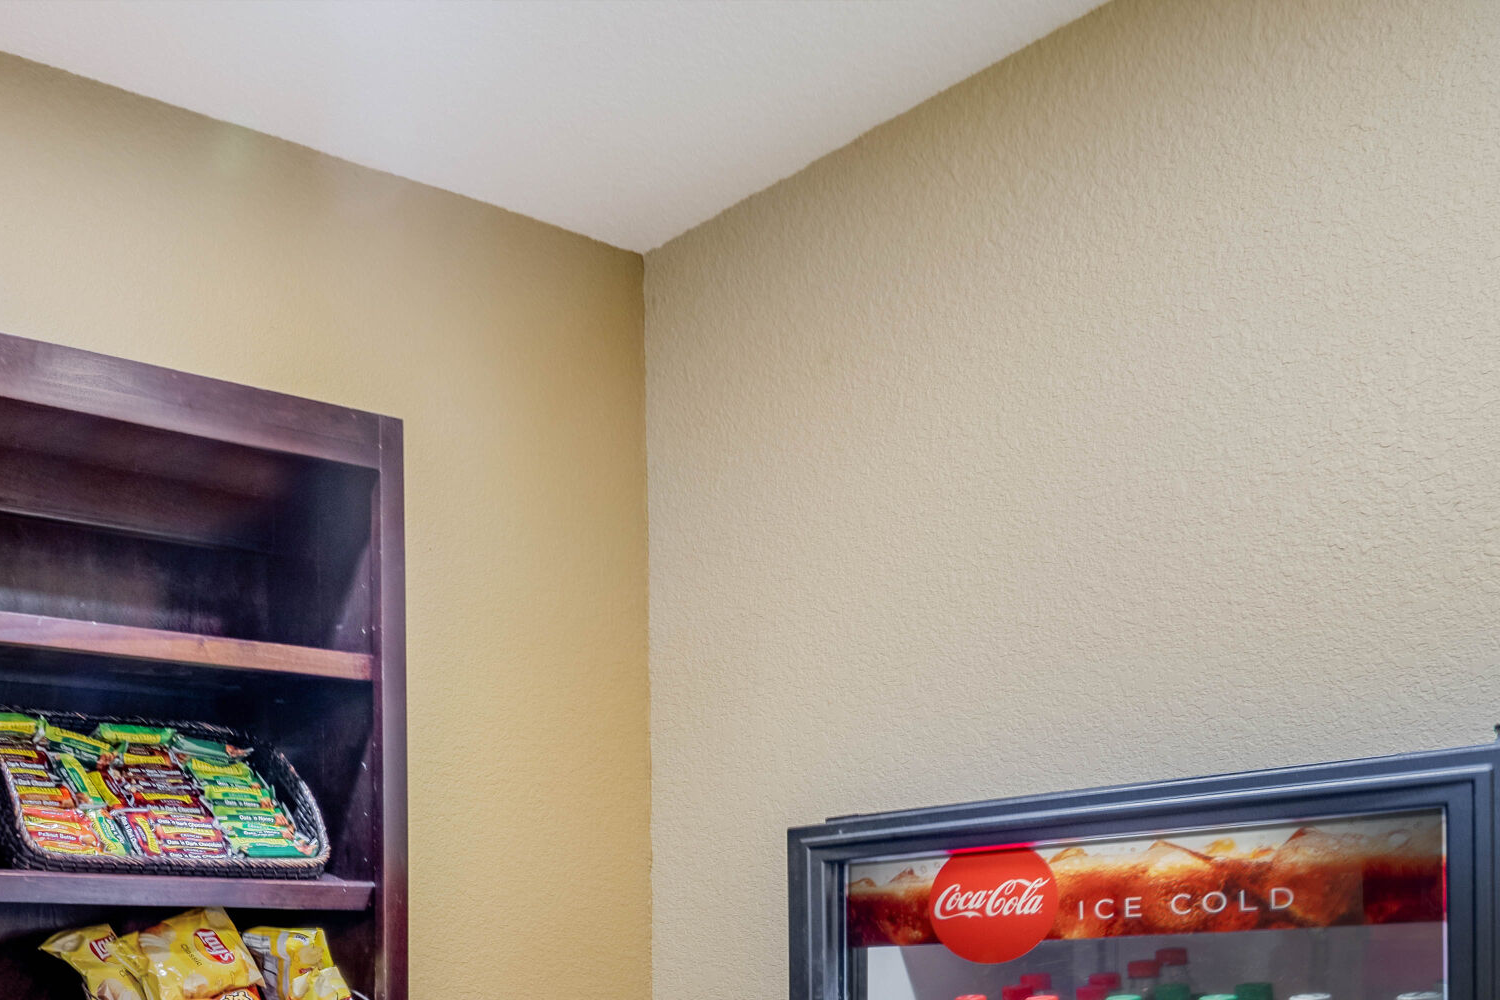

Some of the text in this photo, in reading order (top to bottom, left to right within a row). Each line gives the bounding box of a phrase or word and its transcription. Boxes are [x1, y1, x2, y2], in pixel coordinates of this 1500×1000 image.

[933, 876, 1049, 920] Coca-Cola
[1078, 886, 1295, 921] ICE COLD
[180, 943, 204, 967] Classic
[196, 930, 235, 963] Lay's
